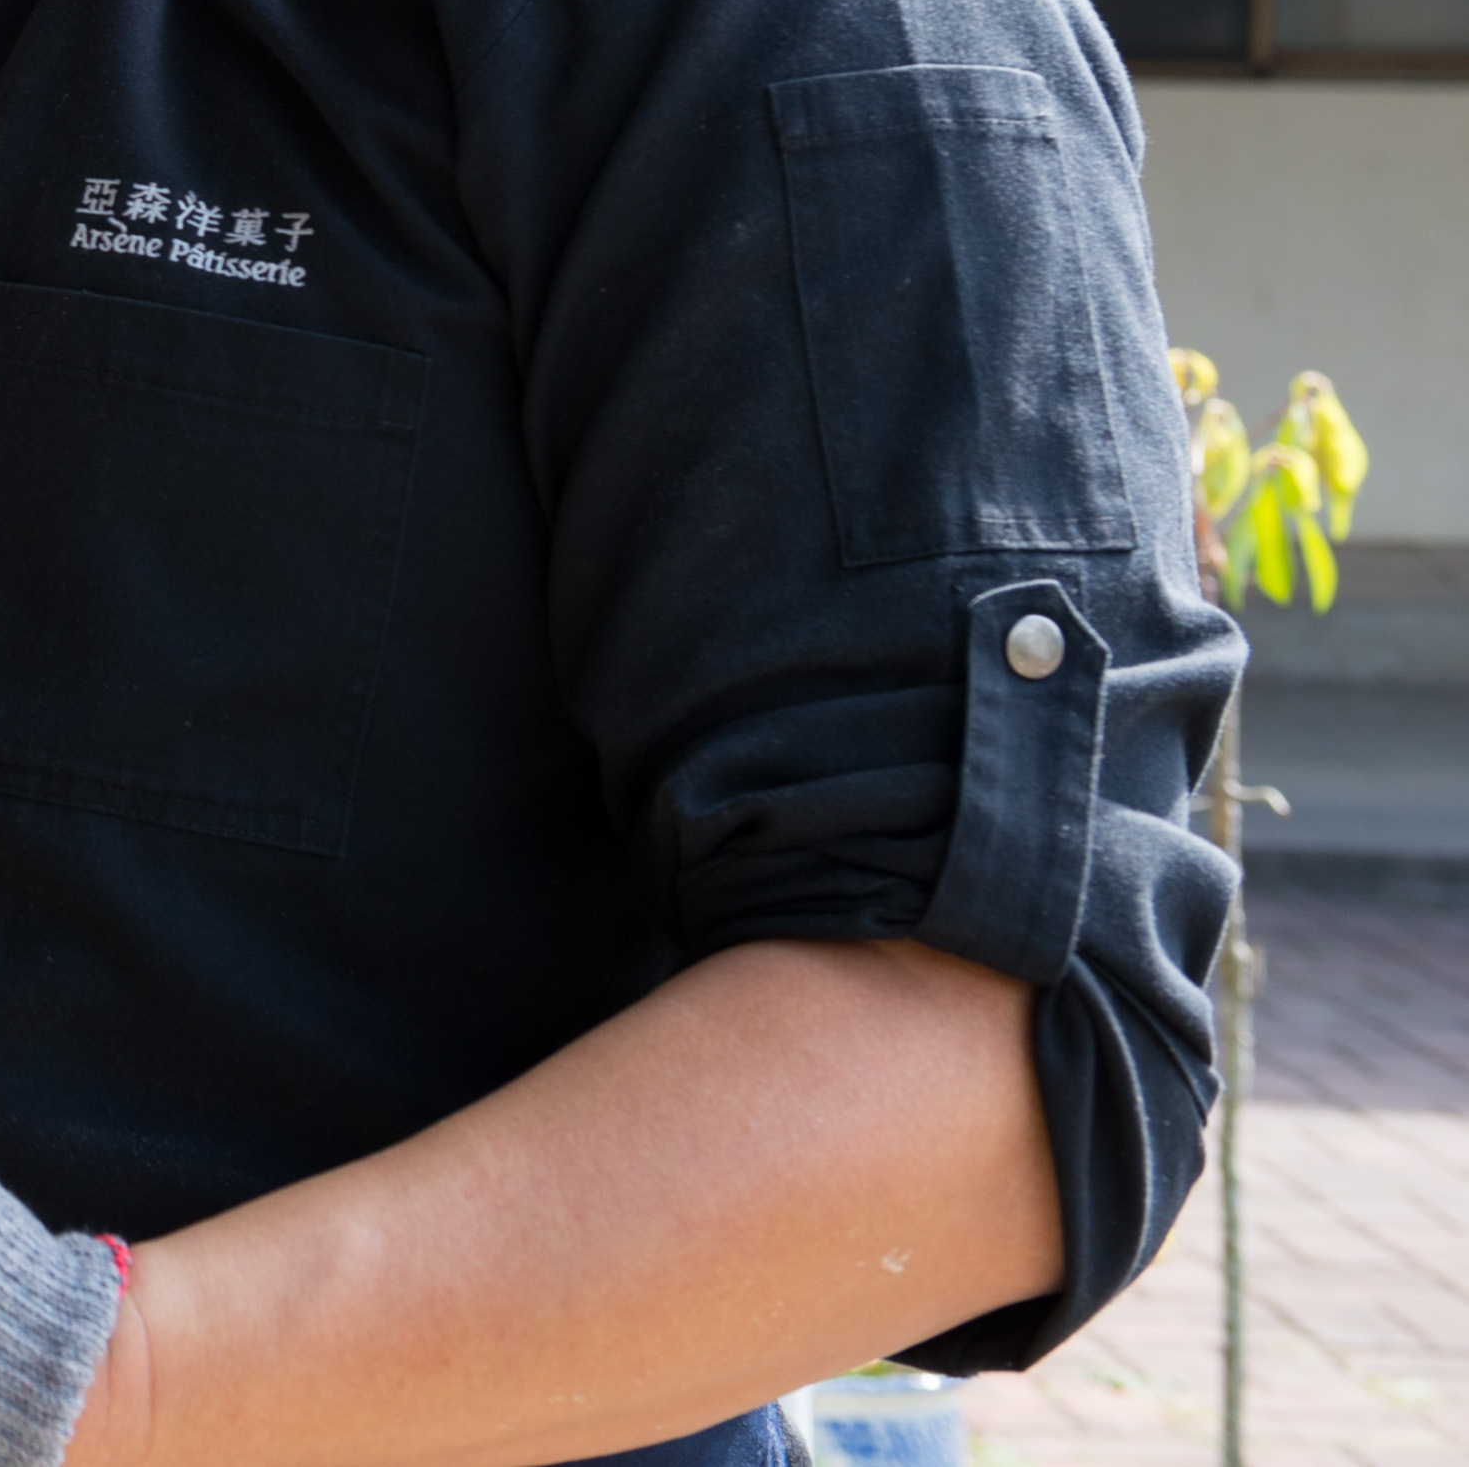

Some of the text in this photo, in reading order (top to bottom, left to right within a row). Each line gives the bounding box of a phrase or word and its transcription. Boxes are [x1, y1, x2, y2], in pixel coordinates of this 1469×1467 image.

[76, 178, 314, 252] 亞森洋菓子
[70, 217, 307, 287] Arsène Pâtisserie
